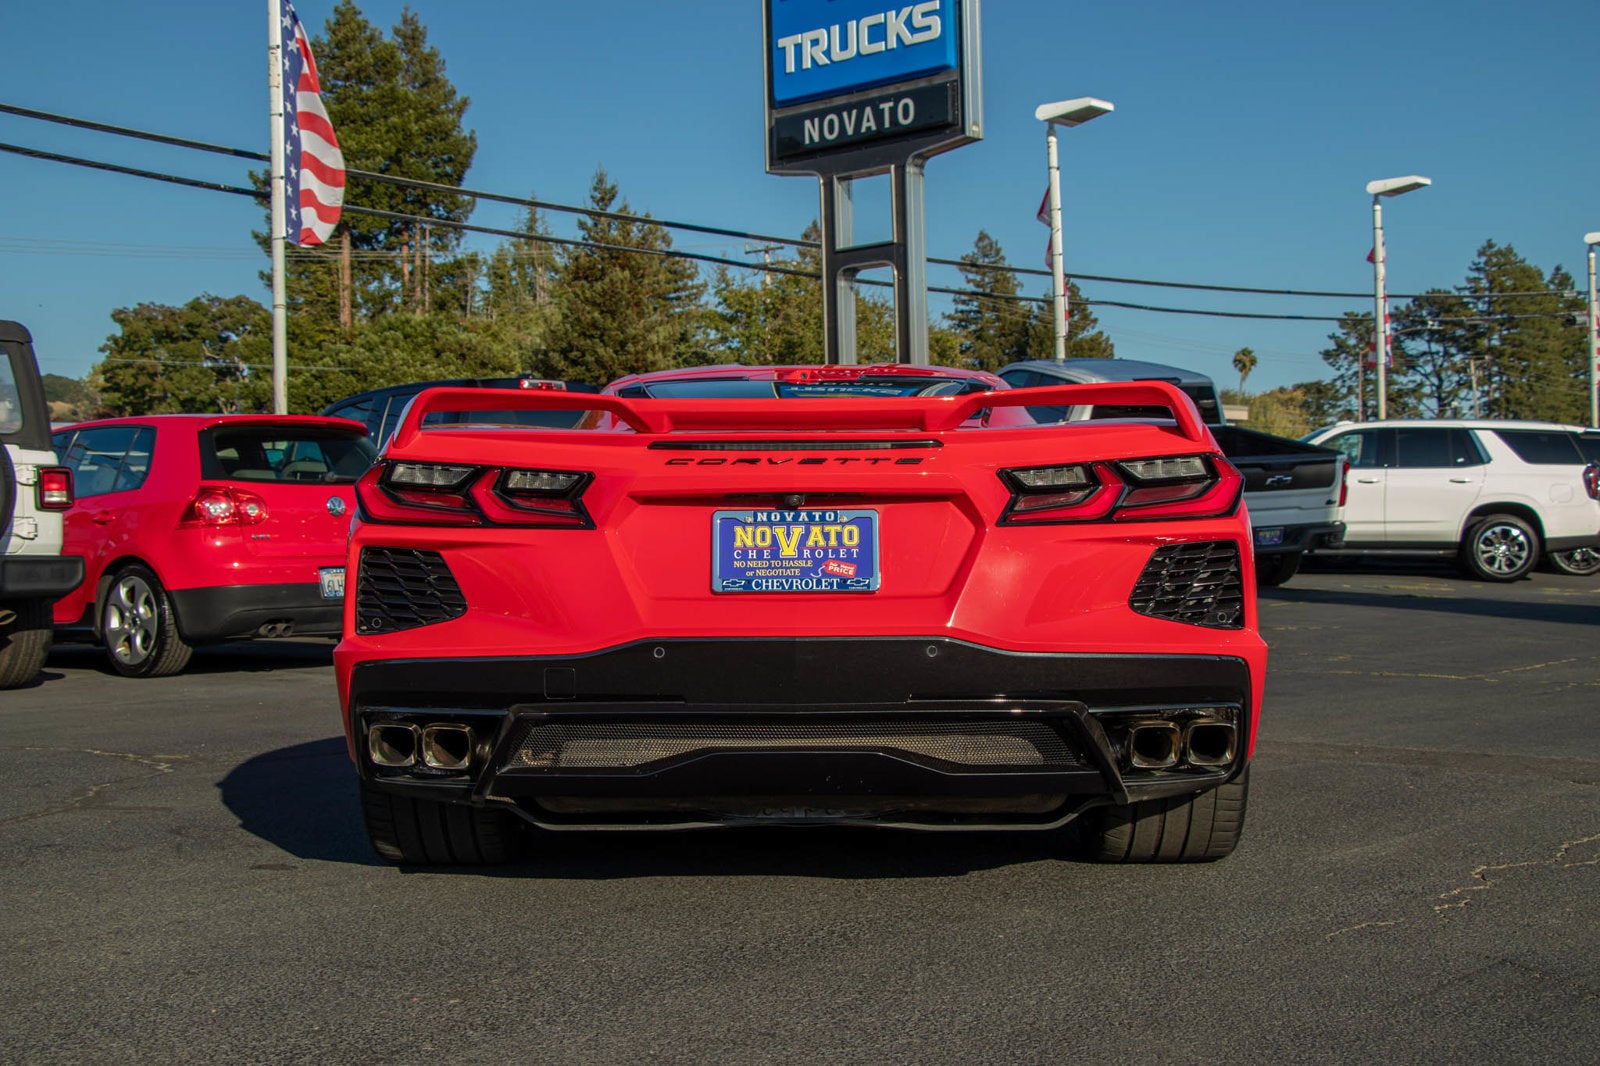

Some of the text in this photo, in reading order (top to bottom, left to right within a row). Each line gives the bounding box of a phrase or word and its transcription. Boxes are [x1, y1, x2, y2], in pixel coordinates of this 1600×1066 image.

[778, 0, 941, 73] TRUCKS
[804, 97, 915, 145] NOVATO
[757, 511, 835, 522] NOVATO
[734, 525, 860, 558] NOVATO
[734, 560, 746, 568] NO
[747, 560, 769, 568] NEED
[782, 560, 813, 568] HASSLE
[756, 569, 801, 577] NEGOTIATE
[828, 565, 854, 576] PRICE
[751, 578, 841, 590] CHEVROLET
